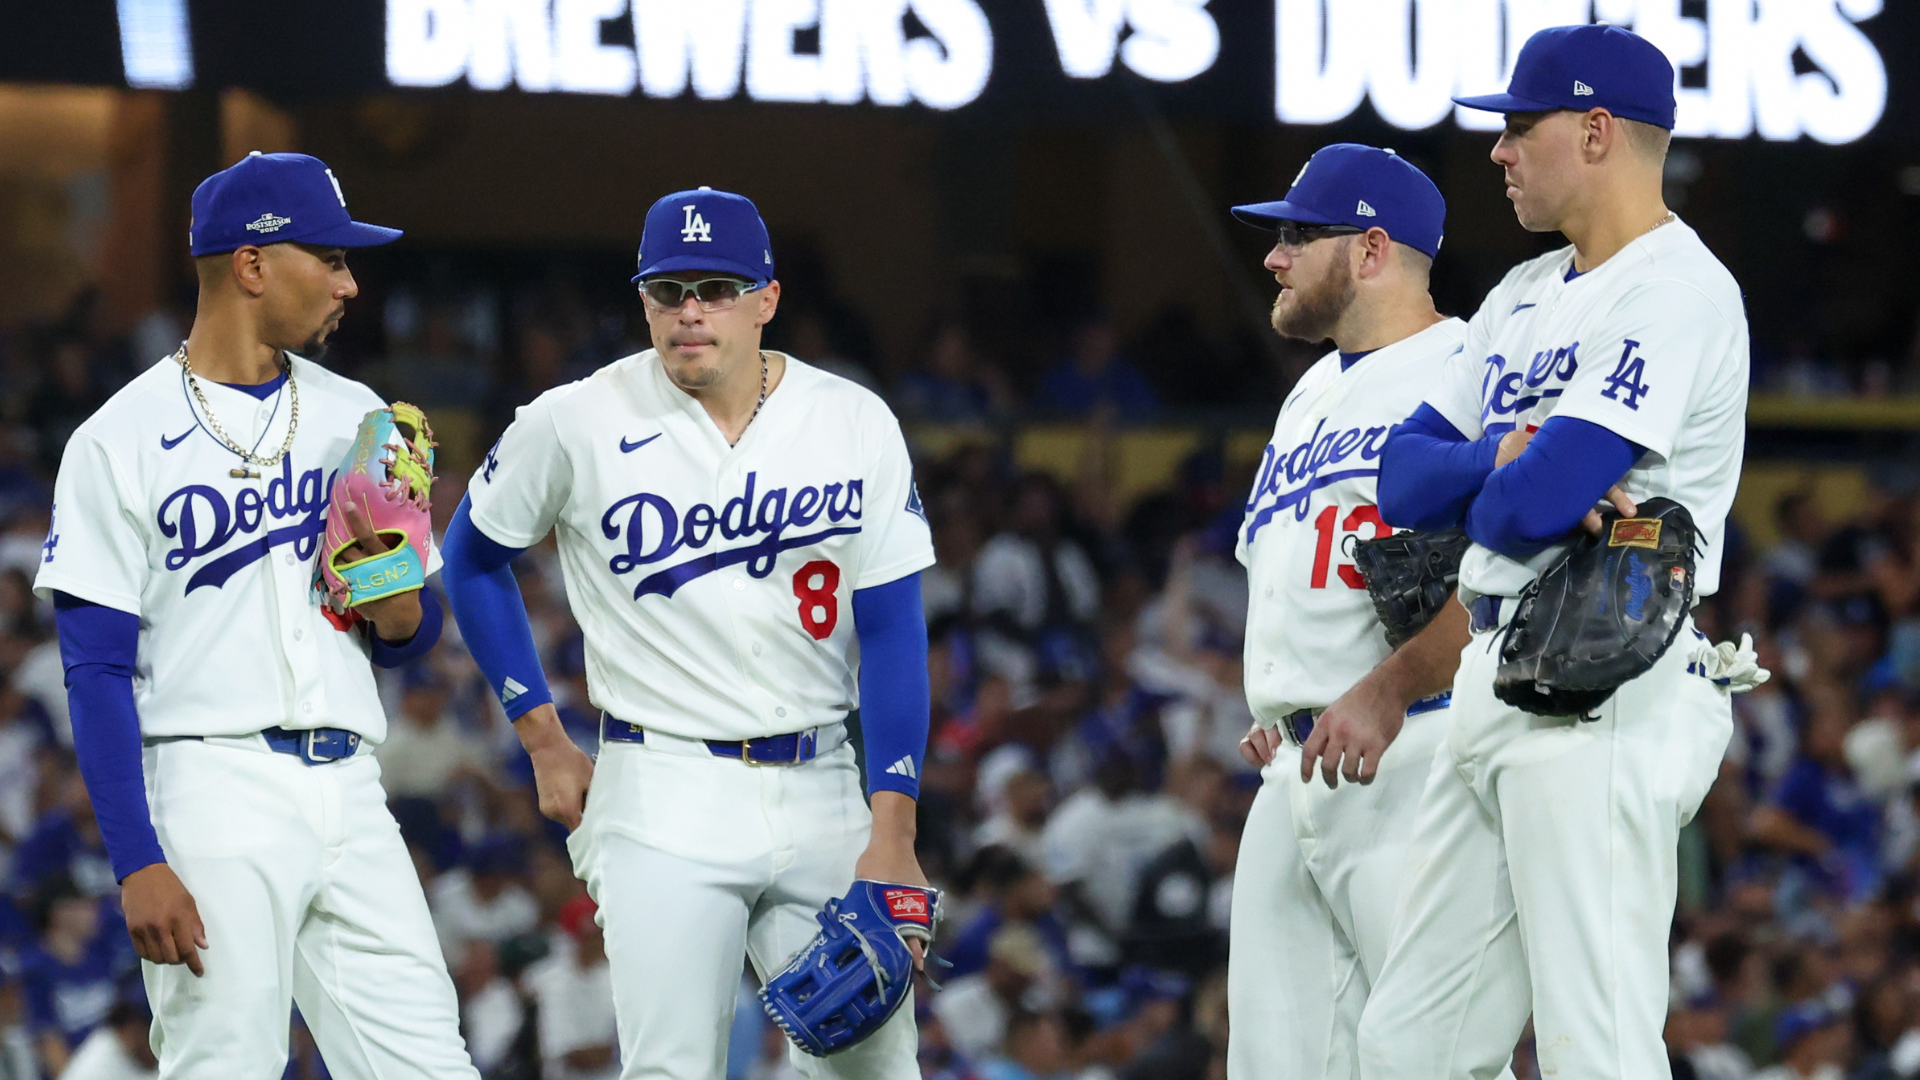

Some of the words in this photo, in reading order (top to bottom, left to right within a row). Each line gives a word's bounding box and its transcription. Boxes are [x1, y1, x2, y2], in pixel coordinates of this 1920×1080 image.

[385, 0, 993, 110] BREWERS
[1274, 0, 1888, 145] DODERS
[245, 217, 292, 231] POSTSEASON
[680, 204, 713, 243] LA
[1600, 338, 1650, 411] LA
[1245, 415, 1388, 522] Dodger
[157, 451, 339, 571] Dodg
[601, 471, 863, 579] Dodgers
[1310, 505, 1393, 589] 13
[792, 559, 841, 641] 8
